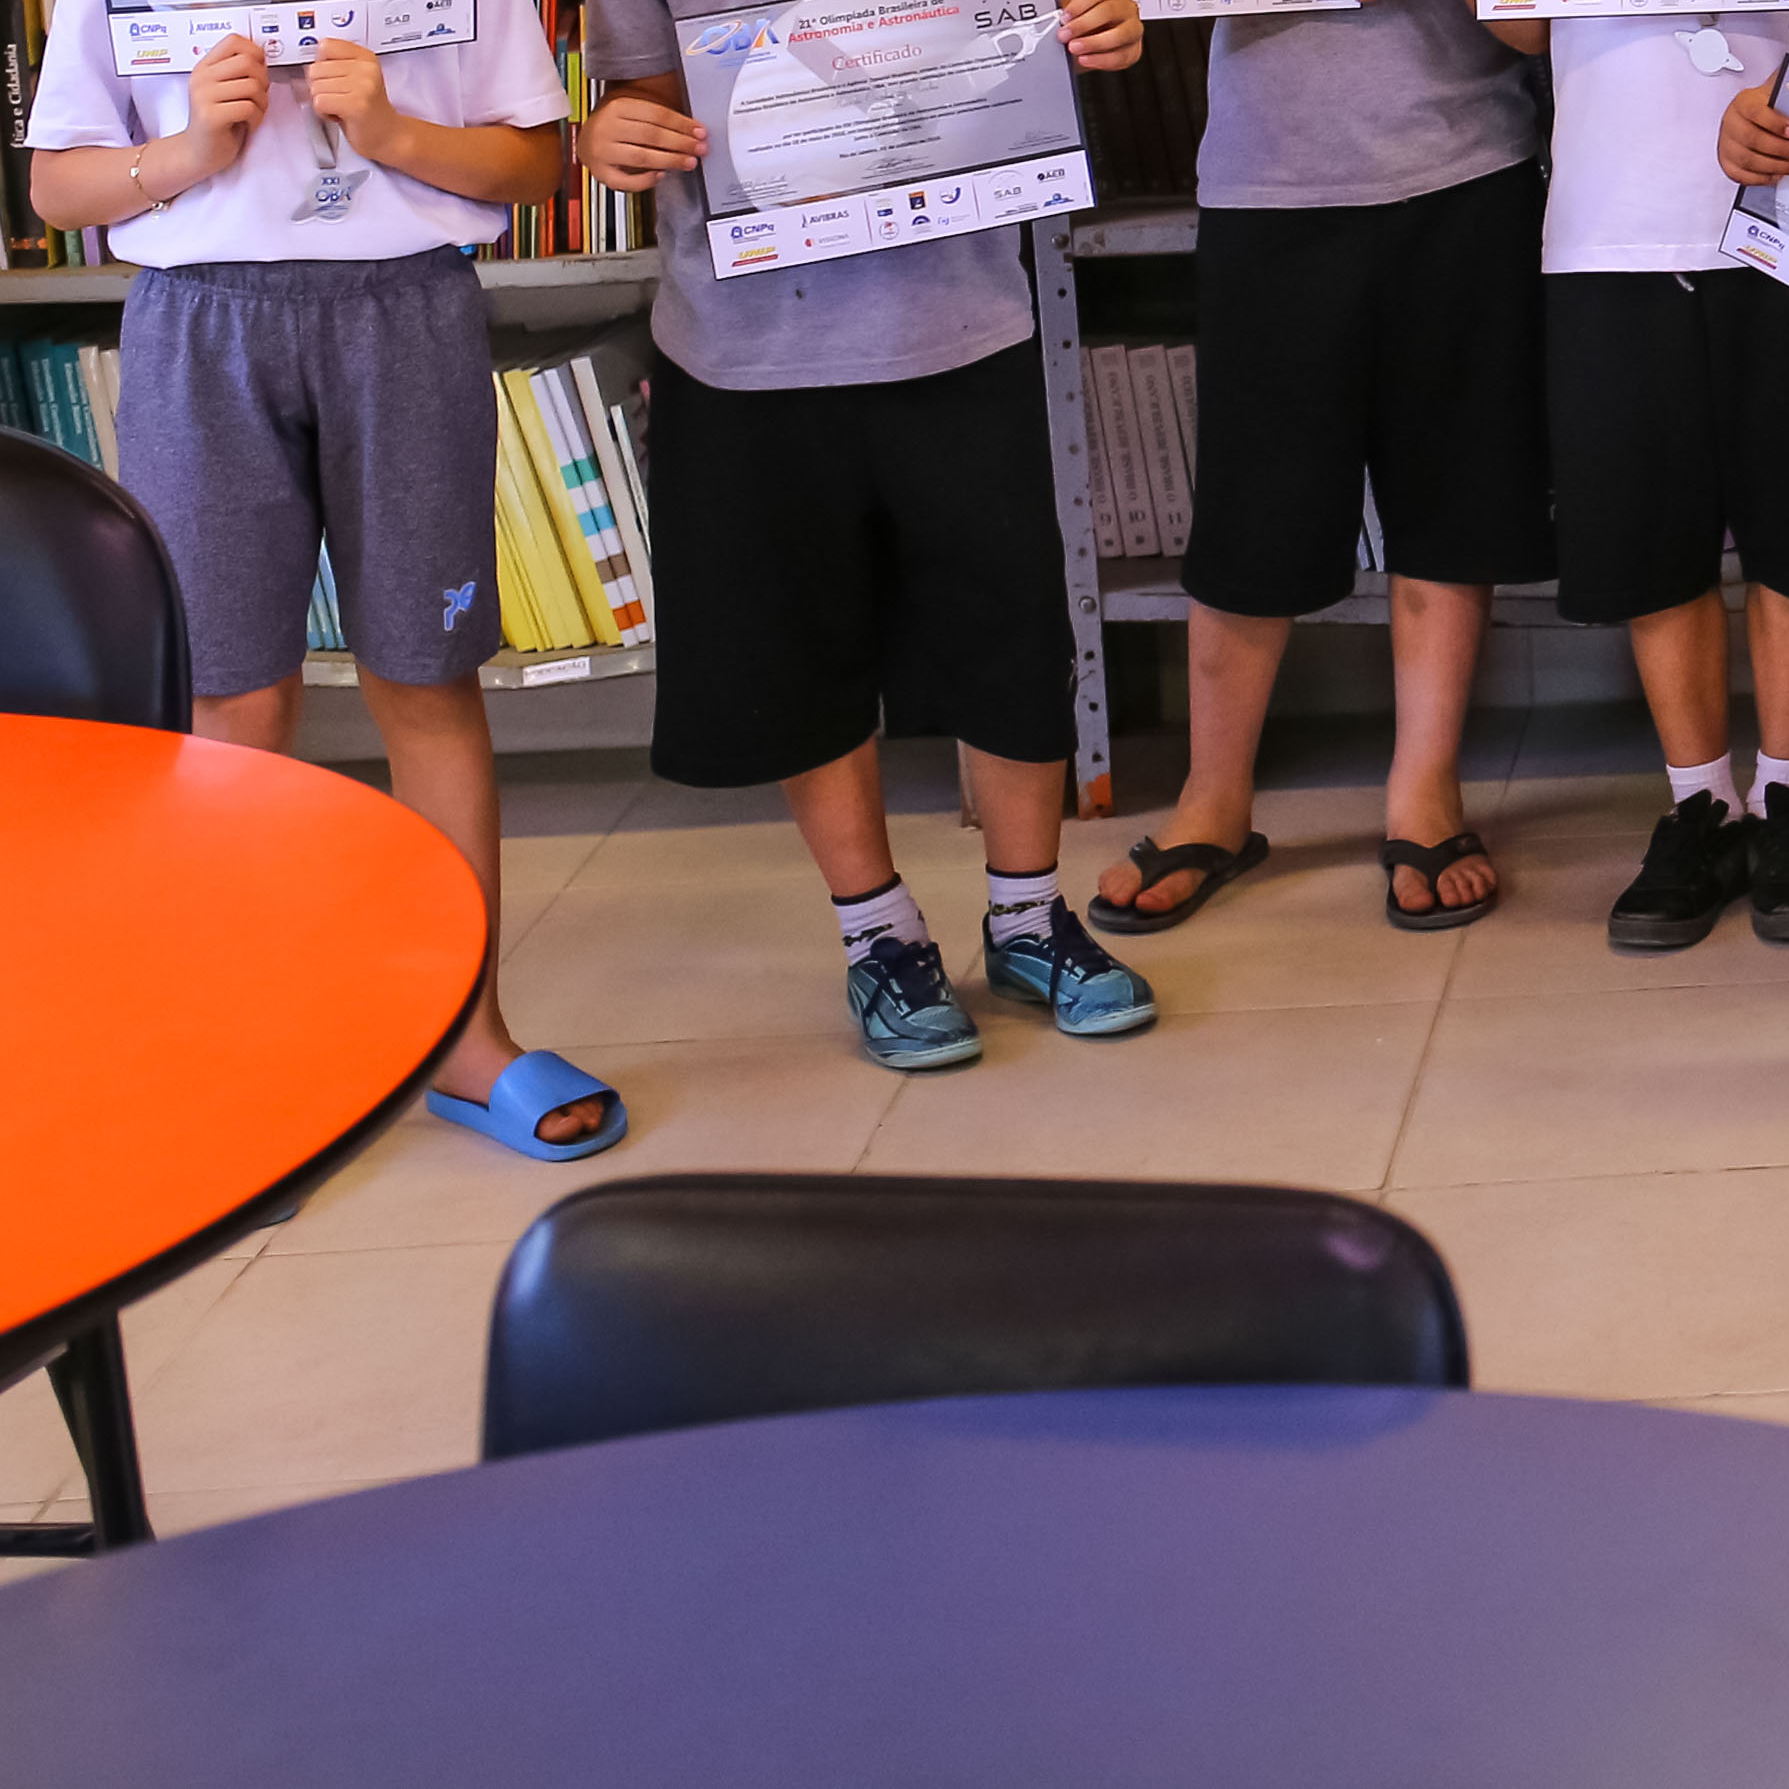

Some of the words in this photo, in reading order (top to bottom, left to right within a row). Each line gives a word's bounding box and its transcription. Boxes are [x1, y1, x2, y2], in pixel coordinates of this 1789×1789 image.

[788, 23, 864, 44] Astronomia
[878, 5, 960, 28] Astronáutica
[820, 8, 876, 27] Olimpíada
[878, 0, 928, 15] Brasileira
[974, 4, 1037, 30] SAB
[831, 44, 922, 71] Certificado
